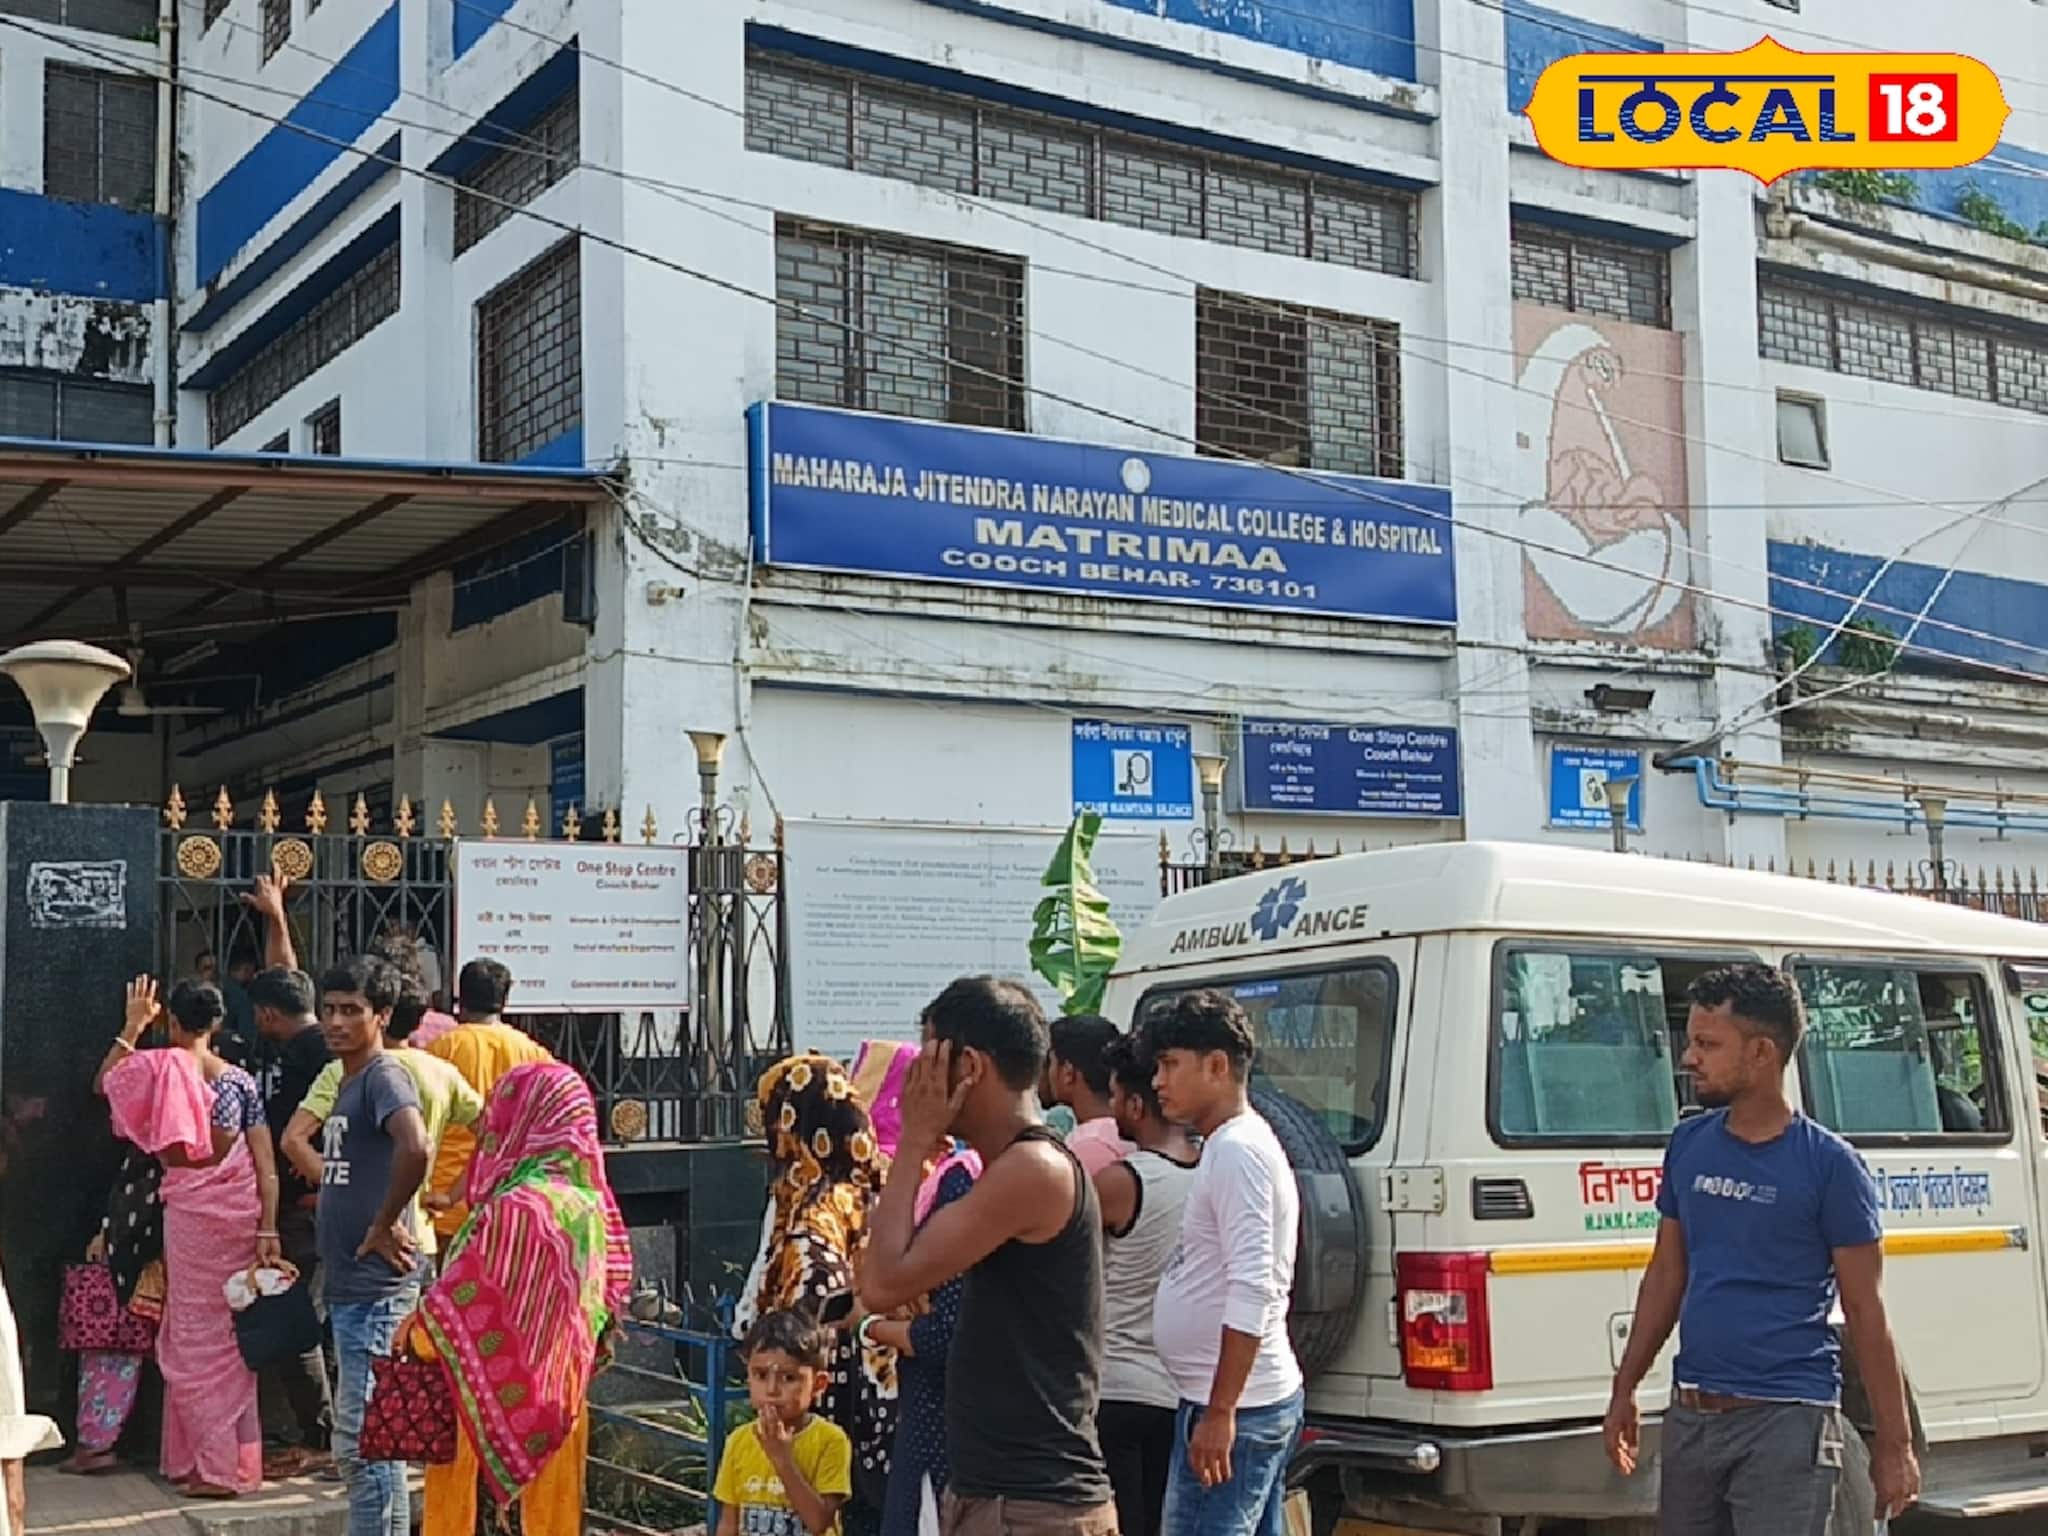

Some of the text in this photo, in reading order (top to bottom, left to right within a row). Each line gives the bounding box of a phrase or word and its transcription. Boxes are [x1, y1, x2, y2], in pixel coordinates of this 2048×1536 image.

[773, 452, 1443, 554] MAHARAJA JITENDRA NARAYAN MEDICAL COLLEGE & HOSPITAL
[975, 517, 1288, 573] MATRIMAA
[942, 549, 1068, 578] COOCH
[1209, 574, 1317, 600] 736101
[1348, 728, 1375, 743] One
[1376, 730, 1406, 748] Stop
[577, 860, 677, 877] One Stop Centre
